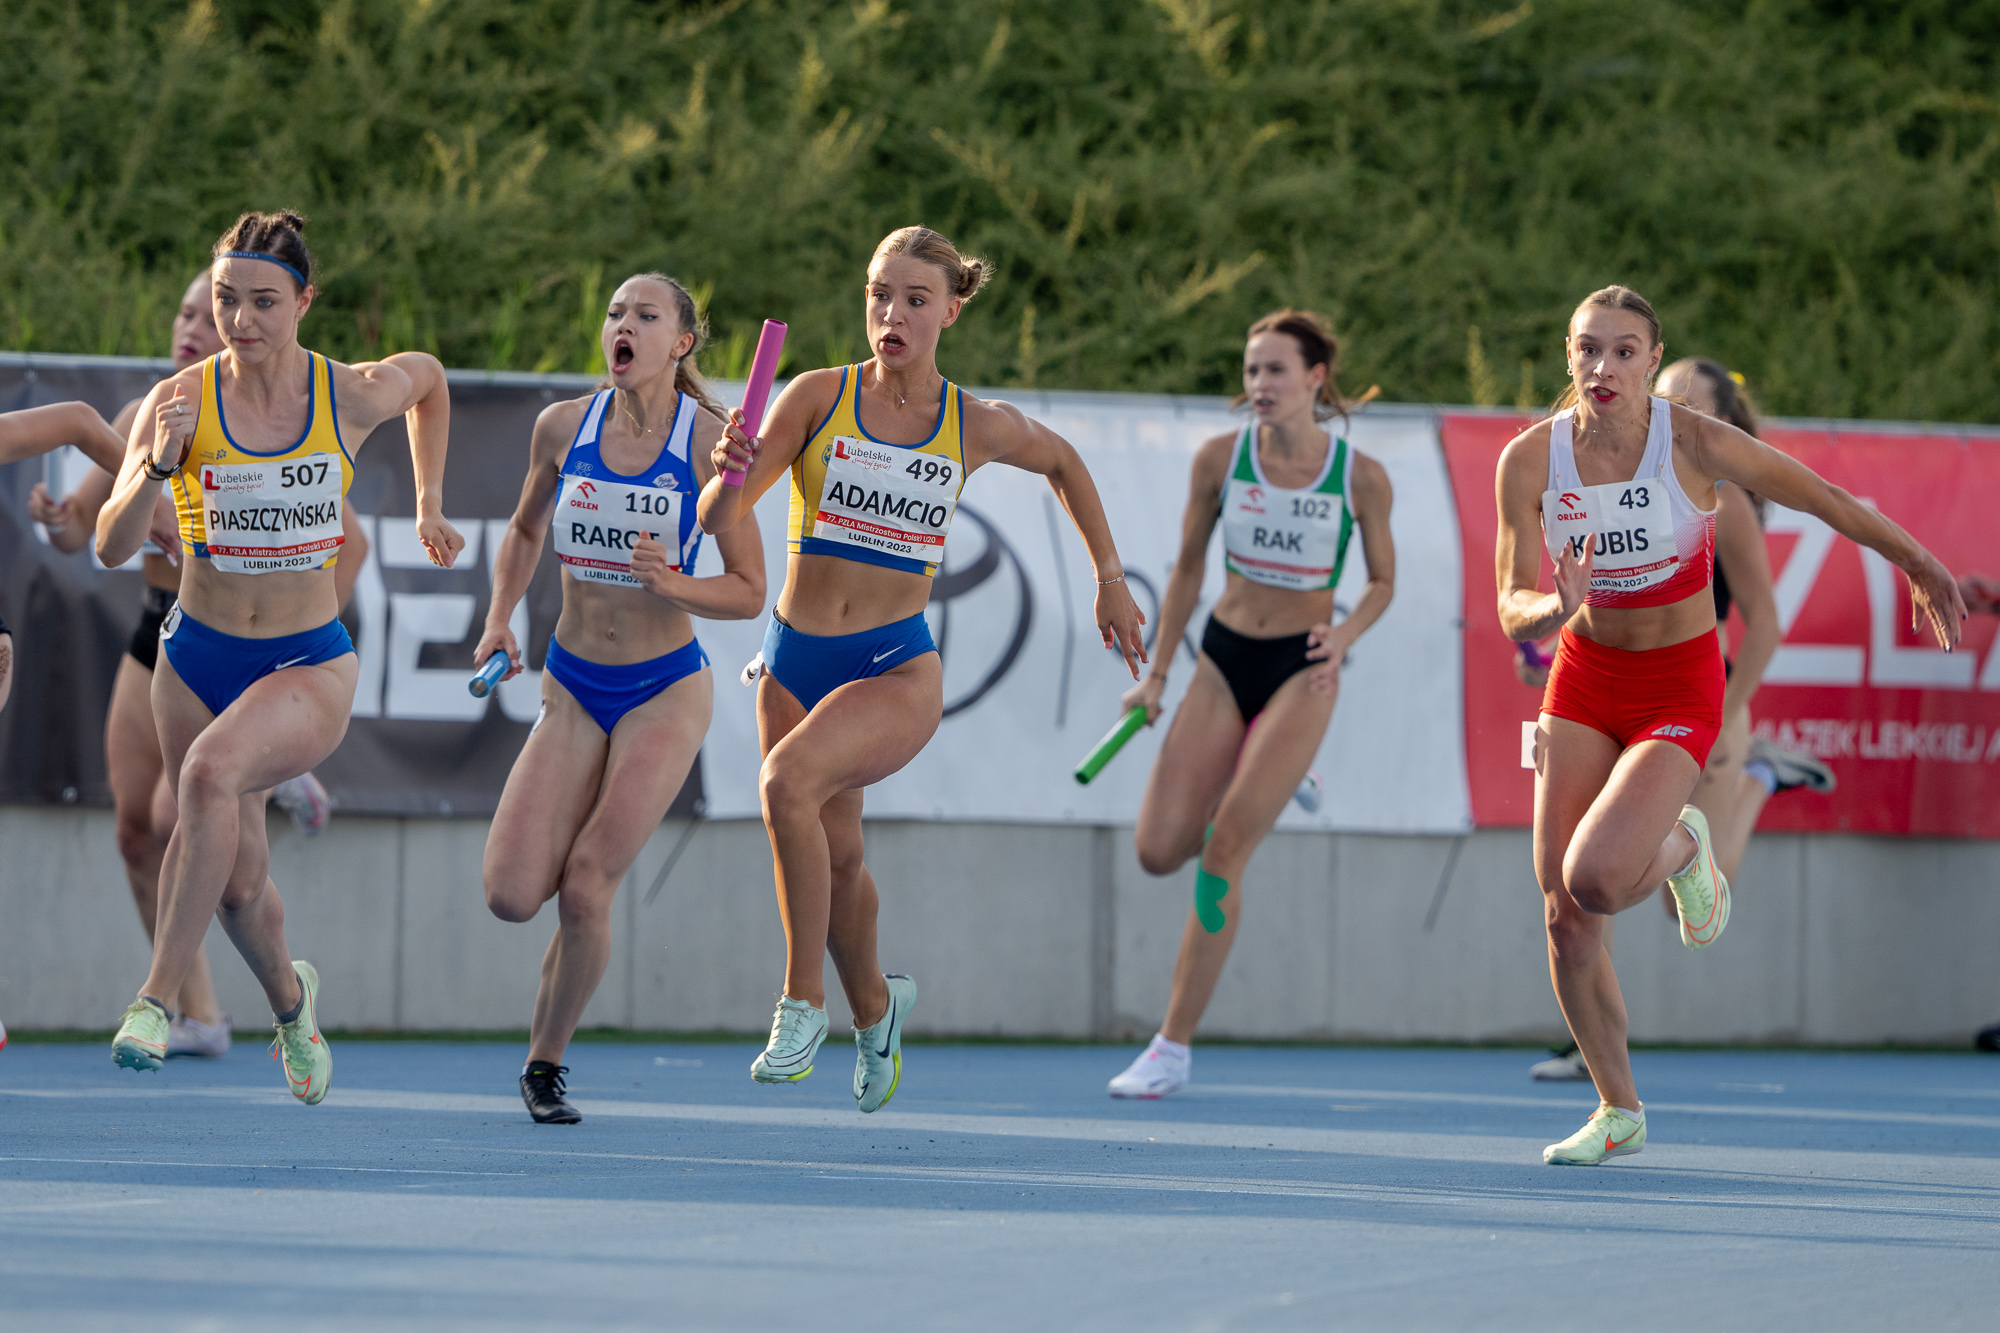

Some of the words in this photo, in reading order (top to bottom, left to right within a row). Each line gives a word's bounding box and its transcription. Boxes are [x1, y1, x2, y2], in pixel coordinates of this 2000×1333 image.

[281, 462, 329, 488] 507
[905, 458, 953, 486] 499
[570, 499, 599, 511] ORLEN
[625, 492, 669, 516] 110
[827, 481, 947, 528] ADAMCIO
[1291, 498, 1331, 520] 102
[1619, 487, 1650, 509] 43
[209, 501, 337, 532] PIASZCZYŃSKA
[1557, 512, 1587, 521] ORLEN
[827, 514, 836, 524] 77.
[838, 518, 855, 528] PZLA
[856, 522, 902, 539] Mistrzostwa
[903, 534, 922, 542] Polski
[923, 536, 936, 544] U20
[1253, 526, 1304, 553] RAK
[229, 548, 247, 556] PZLA
[249, 548, 296, 557] Mistrzostwa
[298, 543, 320, 553] Polski
[322, 539, 337, 549] U20
[848, 532, 885, 547] LUBLIN
[886, 541, 912, 553] 2023
[1569, 528, 1649, 558] KUBIS
[243, 560, 282, 569] LUBLIN
[284, 556, 312, 567] 2023
[1634, 565, 1656, 575] Polski
[1656, 559, 1671, 569] U20
[584, 570, 618, 581] LUBLIN
[1590, 579, 1622, 588] LUBLIN
[1623, 576, 1648, 588] 2023
